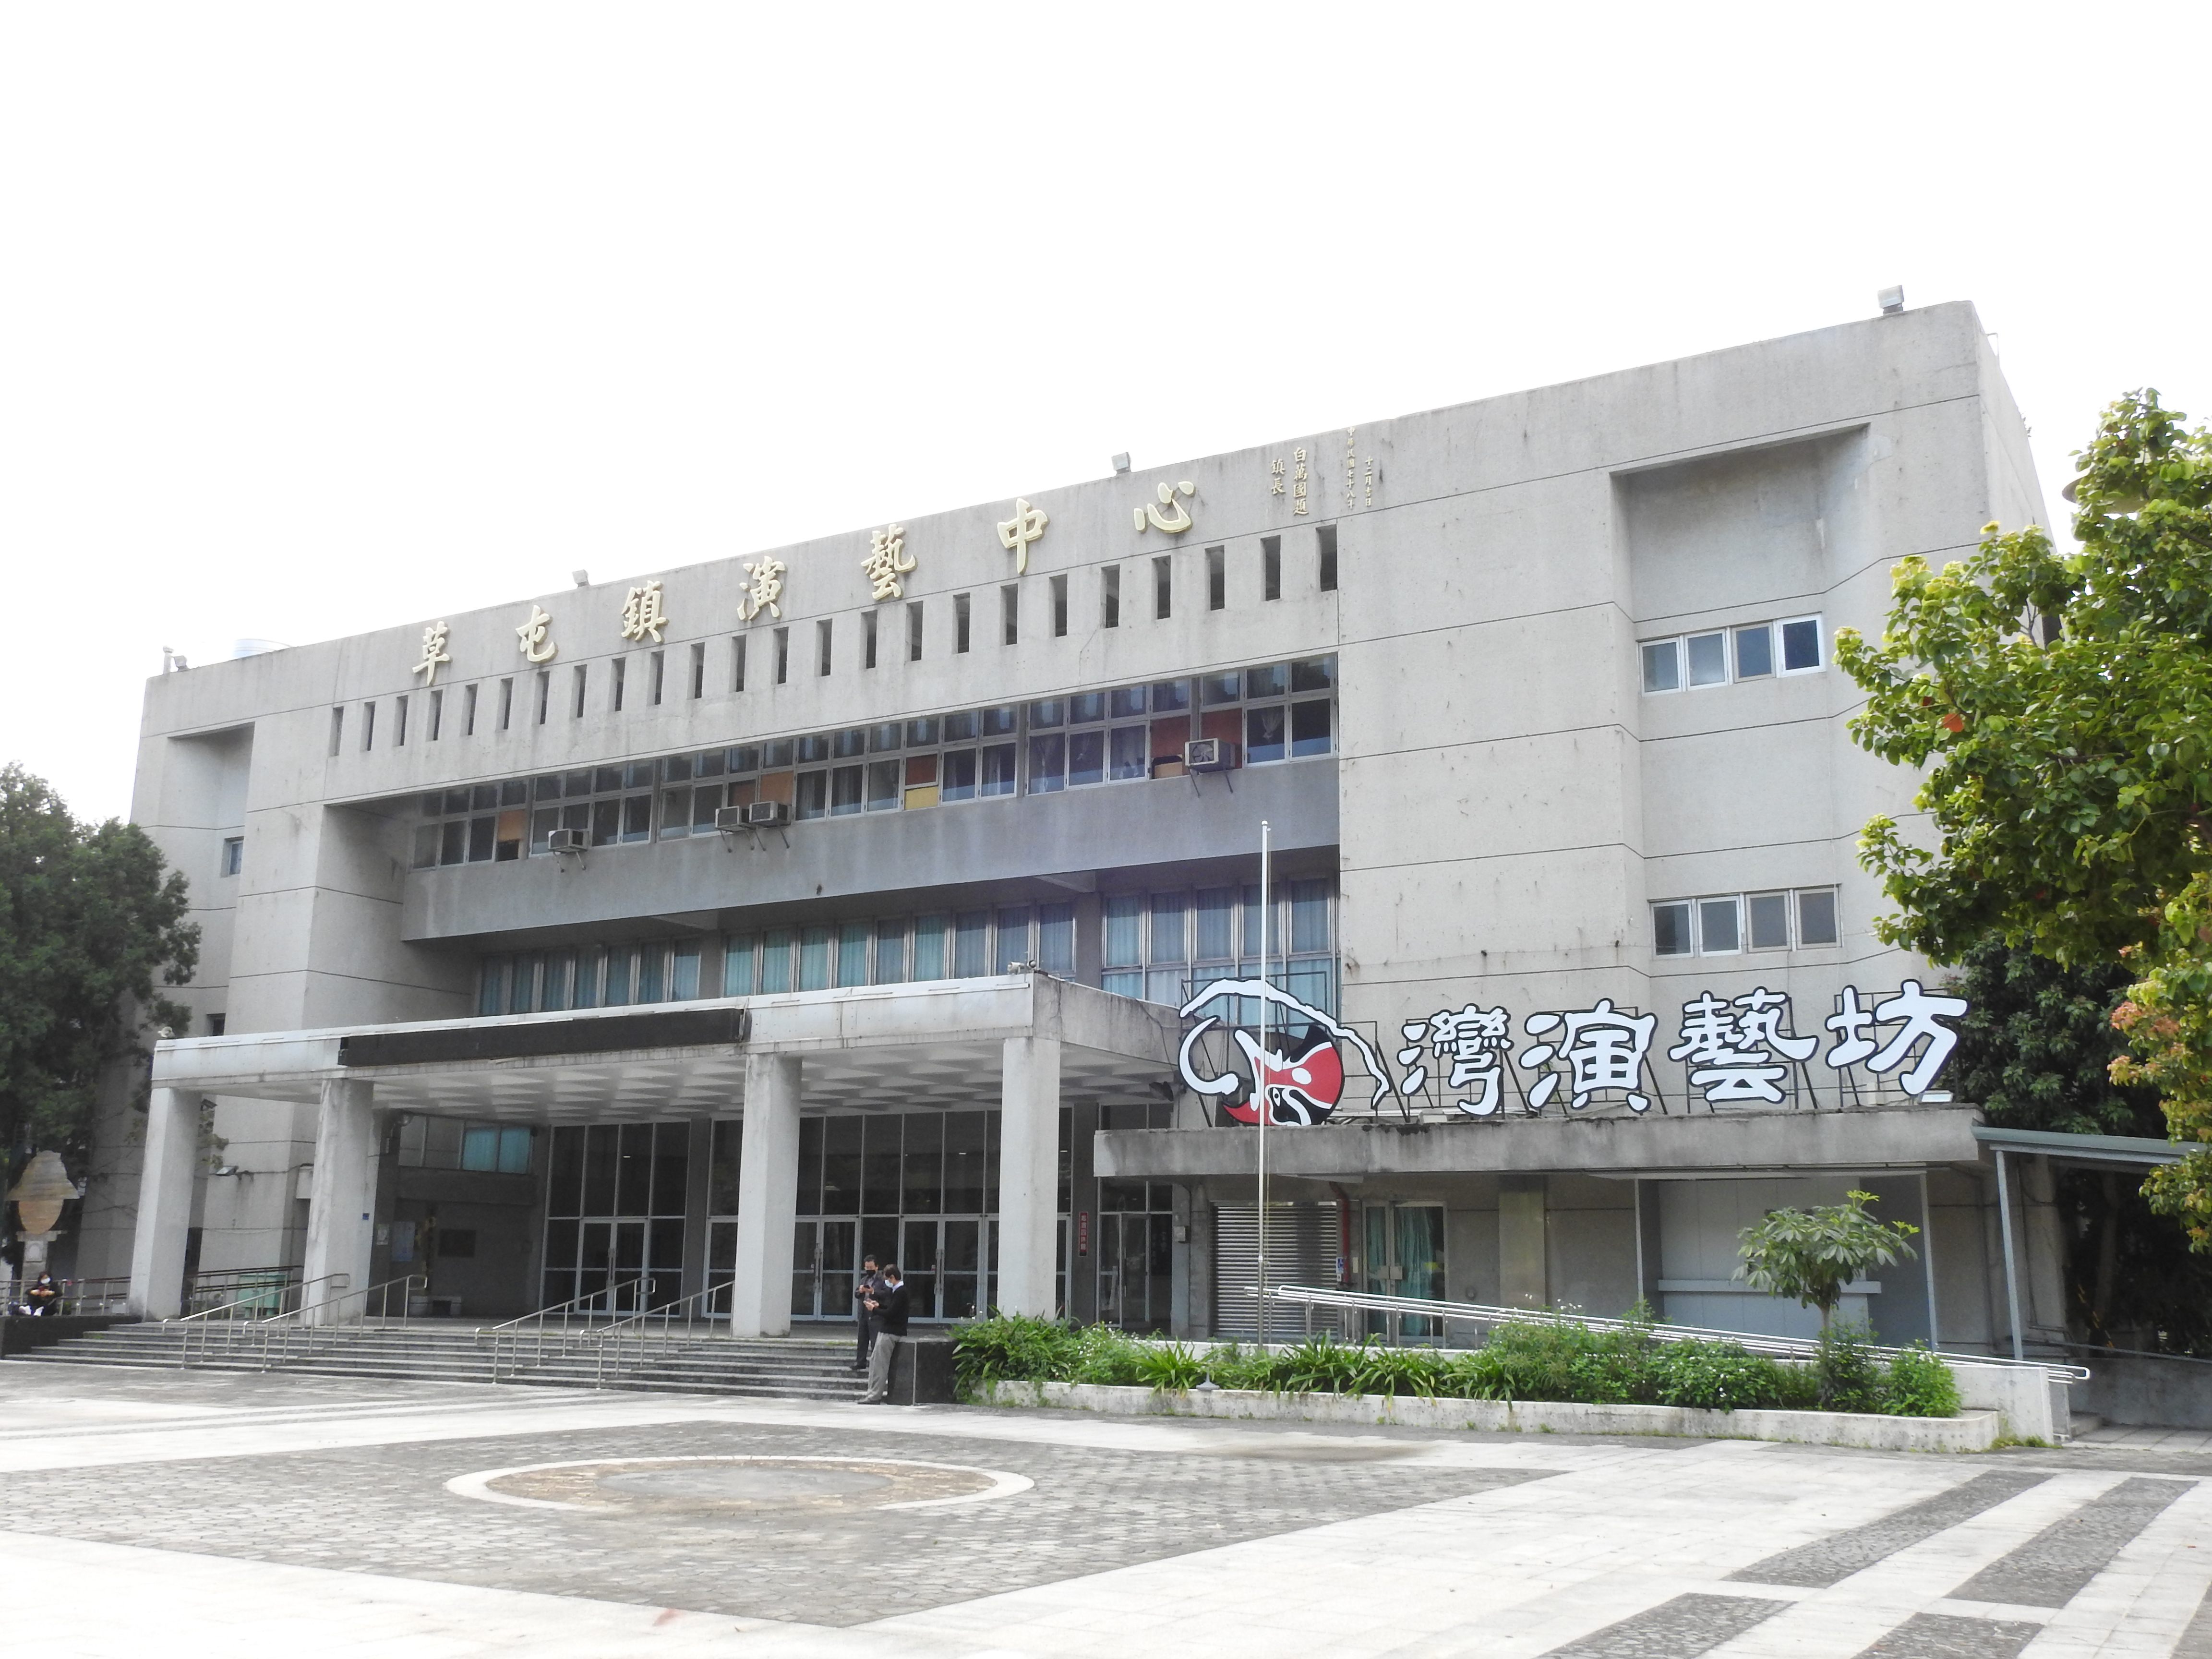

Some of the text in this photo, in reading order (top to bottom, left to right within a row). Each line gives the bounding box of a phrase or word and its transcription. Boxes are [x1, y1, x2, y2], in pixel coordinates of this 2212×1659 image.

[1271, 458, 1286, 494] 鎮長
[413, 481, 1195, 686] 草屯鎮演藝中心
